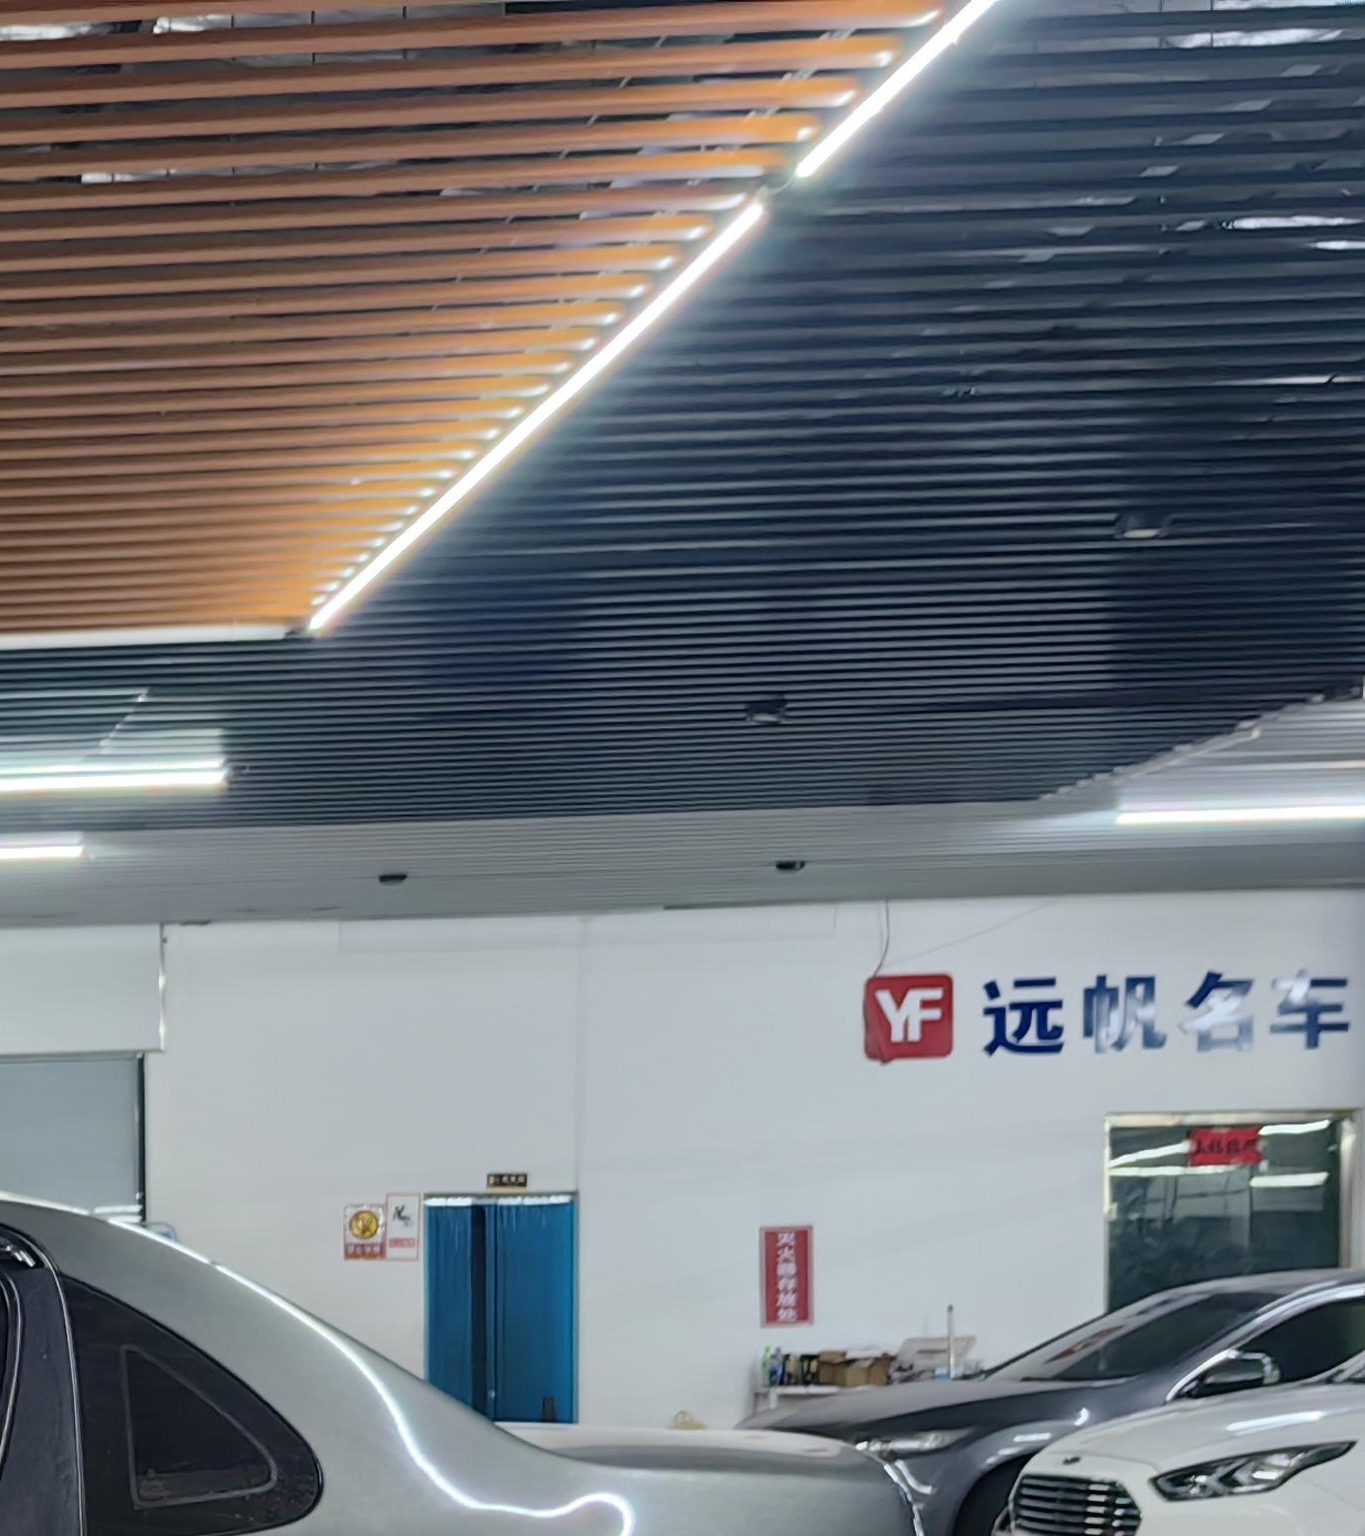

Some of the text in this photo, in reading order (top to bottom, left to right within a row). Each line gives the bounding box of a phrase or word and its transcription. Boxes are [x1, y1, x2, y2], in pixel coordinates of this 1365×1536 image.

[874, 986, 945, 1043] YF
[982, 968, 1351, 1058] 远帆名车
